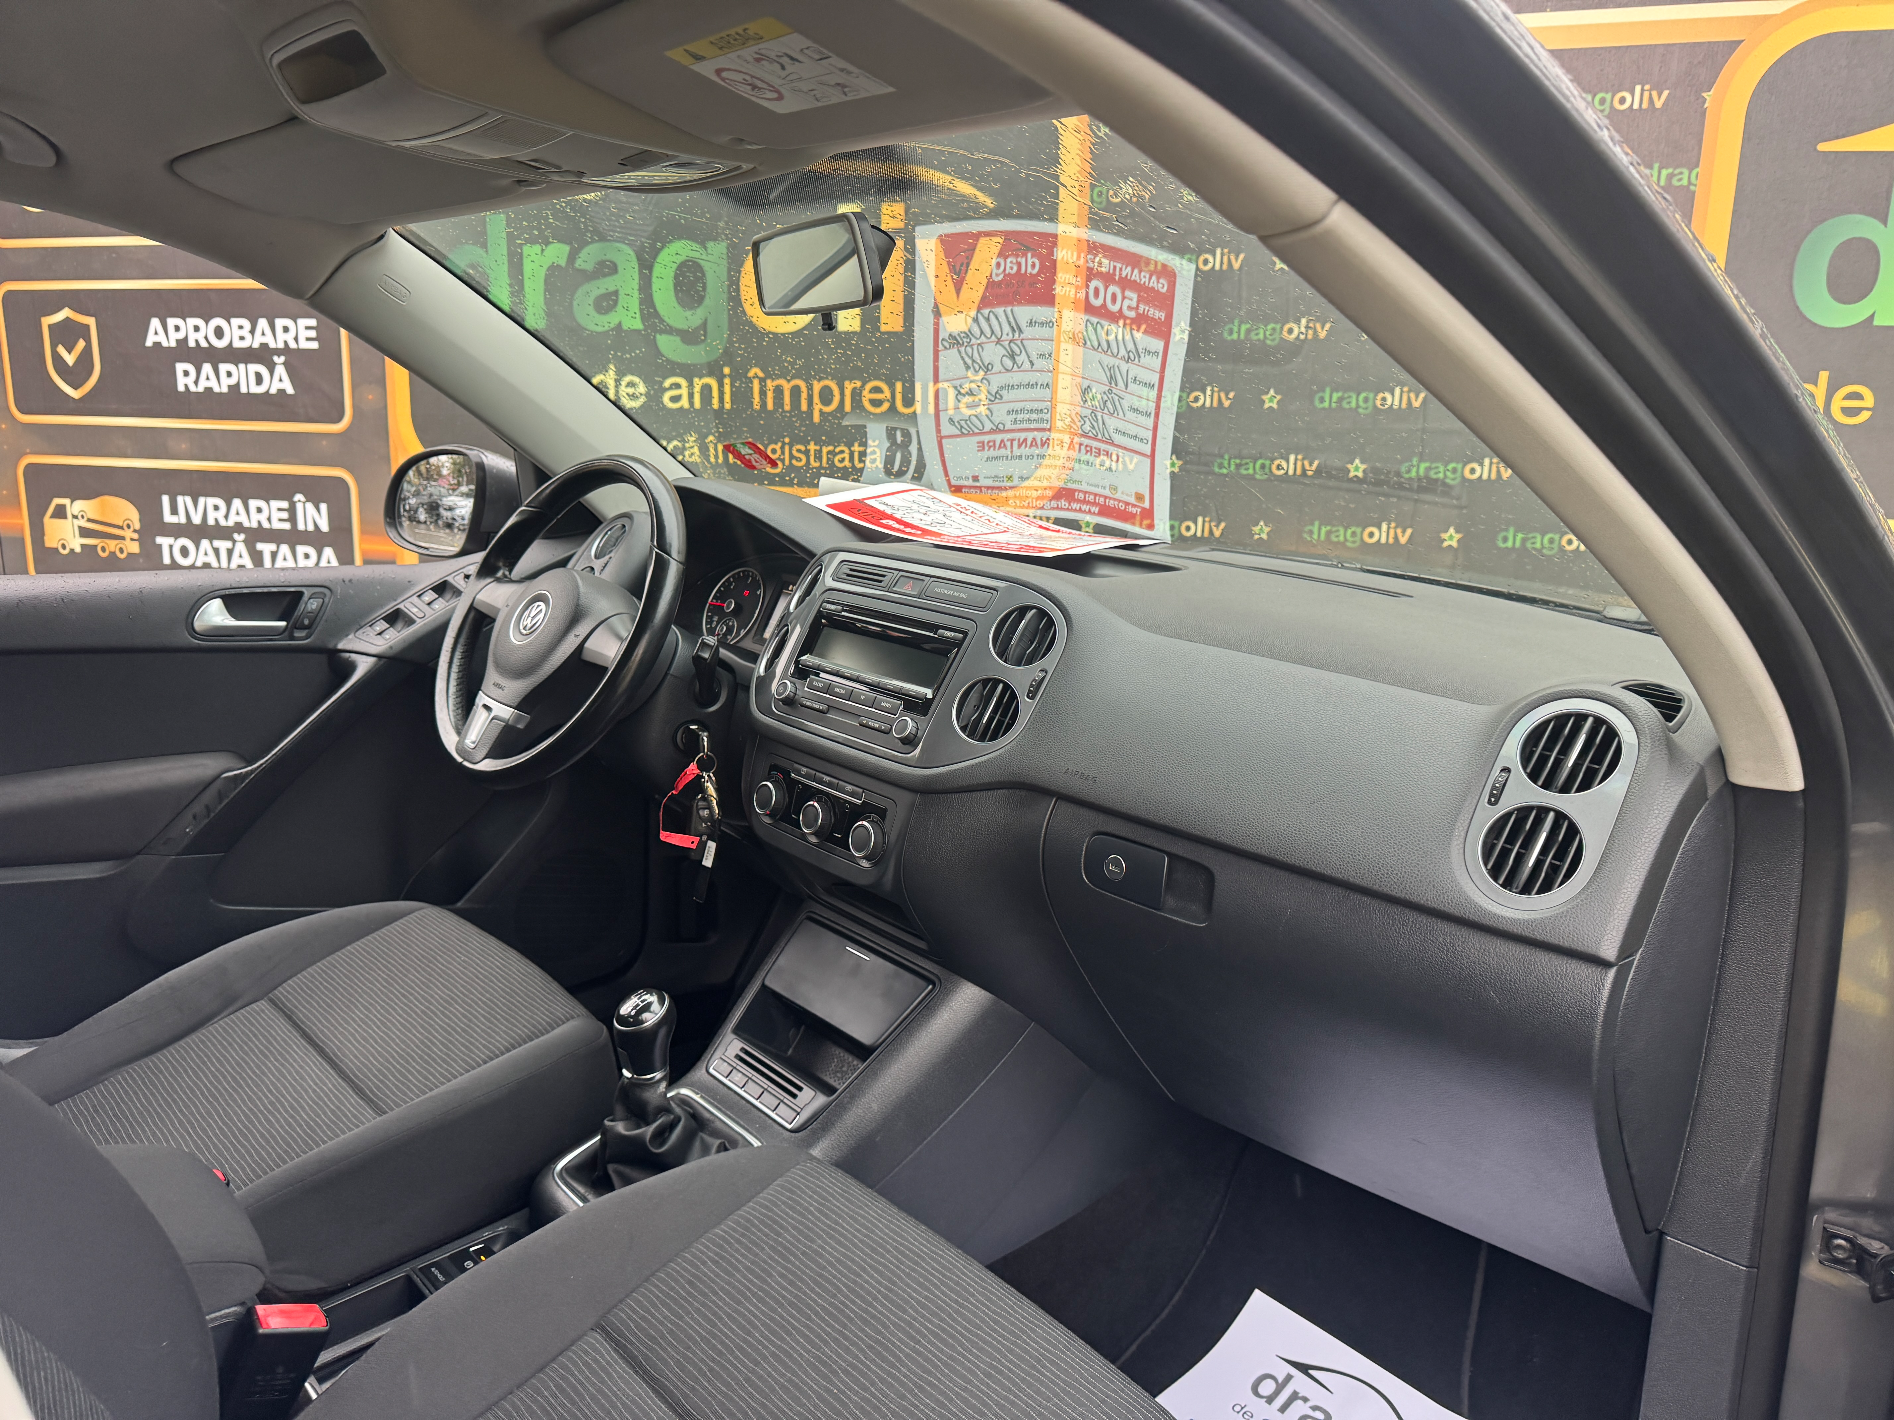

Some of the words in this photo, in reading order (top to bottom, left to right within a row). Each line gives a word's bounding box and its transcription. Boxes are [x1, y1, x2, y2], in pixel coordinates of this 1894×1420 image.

[709, 27, 764, 51] AIRBAG
[145, 317, 319, 350] APROBARE
[1223, 317, 1332, 346] dragoliv
[175, 355, 295, 395] RAPIDĂ
[662, 366, 733, 410] ani
[747, 367, 989, 423] împreună
[1314, 386, 1427, 414] dragoliv
[1802, 371, 1875, 426] de
[1213, 453, 1320, 479] dragoliv
[1402, 457, 1513, 484] dragoliv
[161, 494, 292, 531] LIVRARE
[294, 492, 330, 533] ÎN
[1303, 521, 1413, 547] dragoliv
[155, 533, 254, 569] TOATĂ
